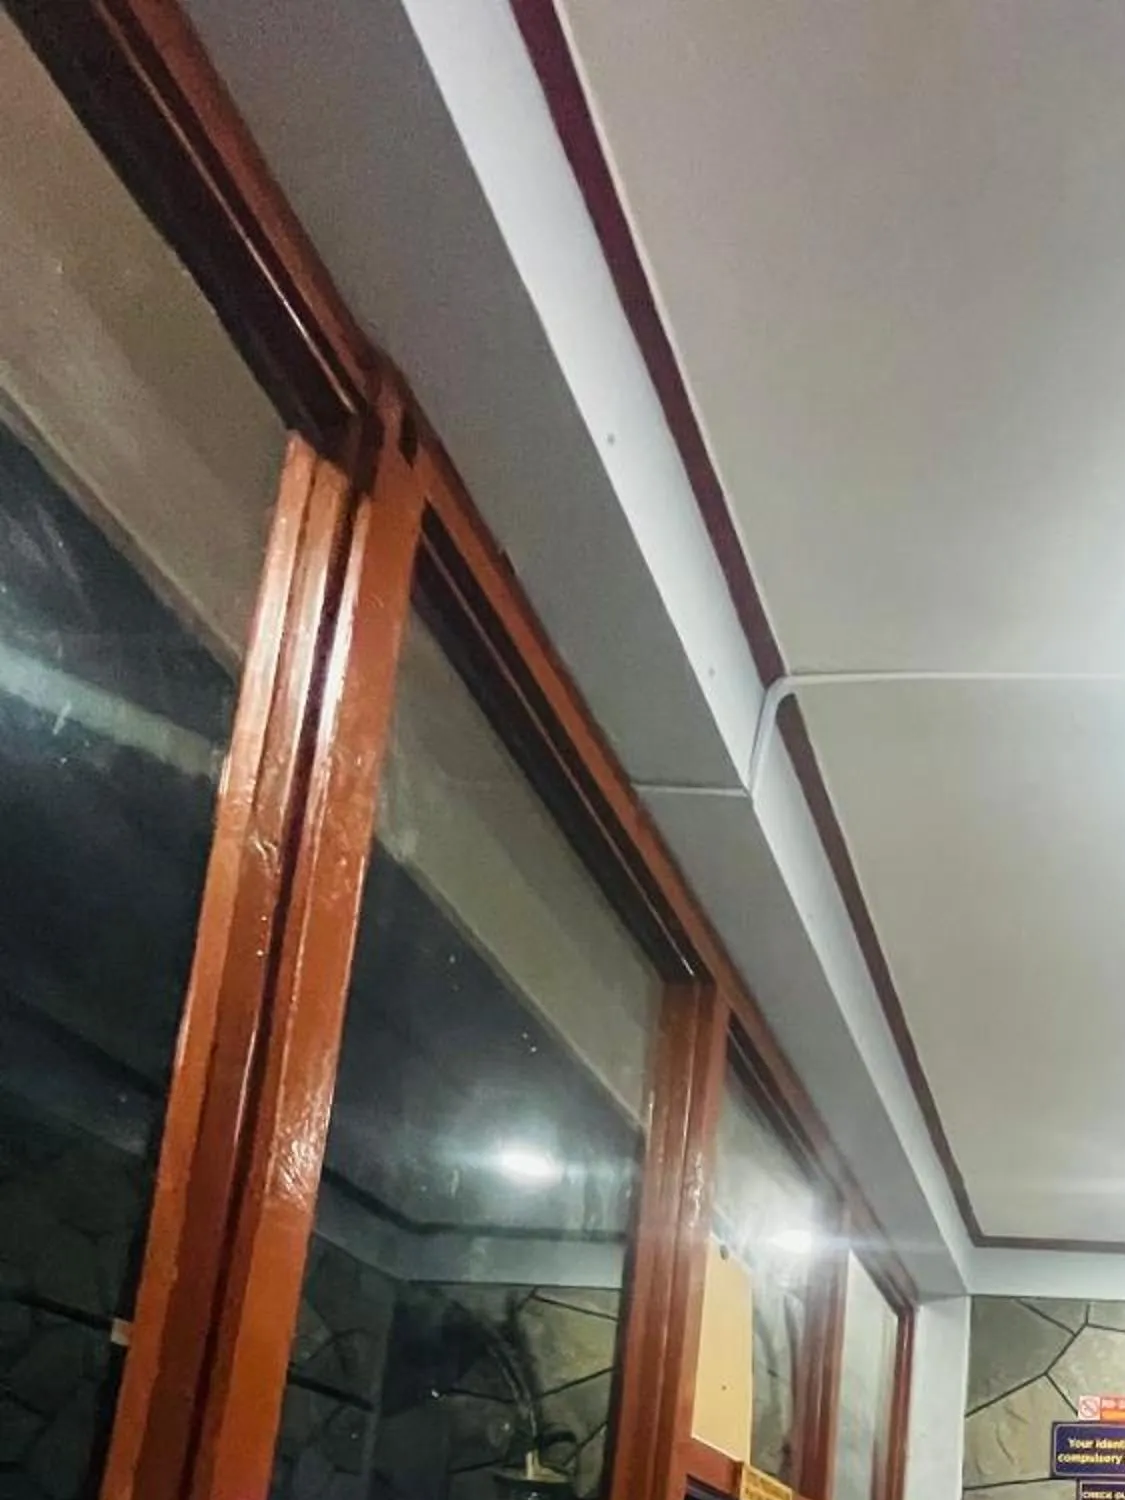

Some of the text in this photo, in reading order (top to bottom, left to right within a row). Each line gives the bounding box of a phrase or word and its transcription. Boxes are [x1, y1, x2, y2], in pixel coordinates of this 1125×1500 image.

[1068, 1438, 1095, 1449] Your
[1057, 1452, 1122, 1465] compulsory
[1083, 1491, 1113, 1499] CHECK
